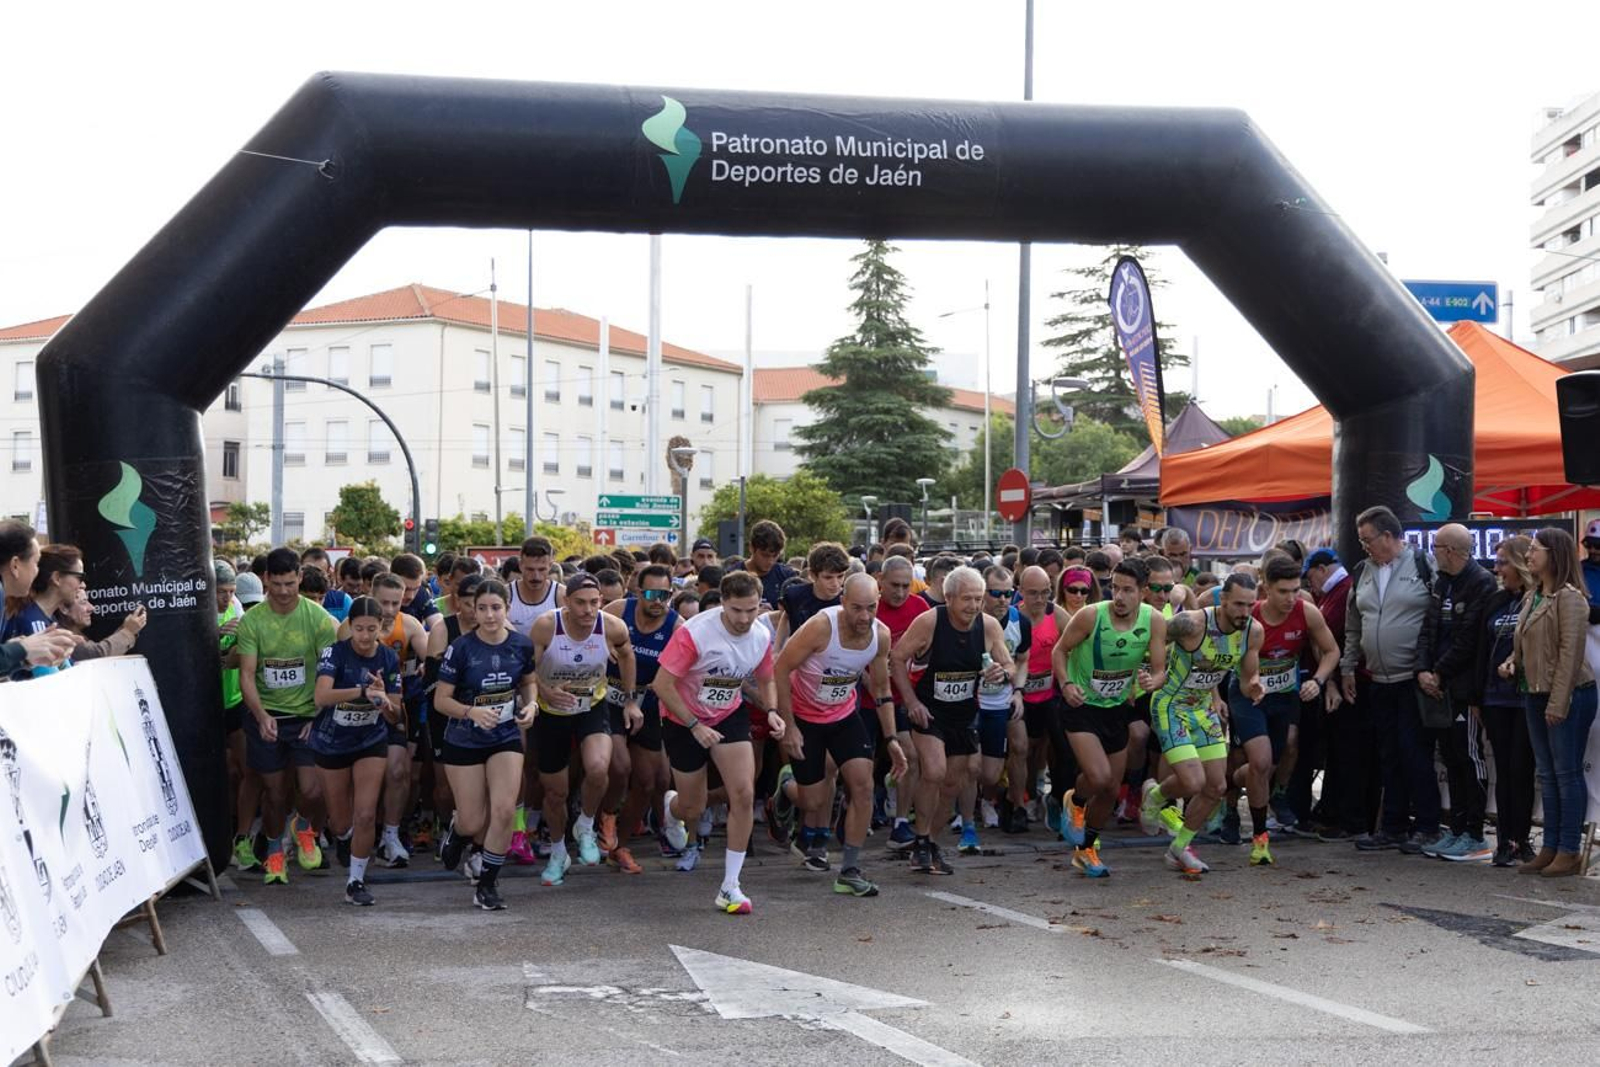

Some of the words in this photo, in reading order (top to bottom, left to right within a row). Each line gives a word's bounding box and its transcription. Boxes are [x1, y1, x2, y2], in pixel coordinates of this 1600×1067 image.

[711, 131, 827, 156] Patronato
[836, 136, 948, 162] Municipal
[956, 141, 985, 161] de
[711, 160, 821, 187] Deportes
[829, 163, 859, 184] de
[866, 163, 922, 186] Jaén
[621, 533, 659, 542] Carrefour
[132, 579, 193, 595] Municipal
[195, 577, 207, 590] de
[148, 597, 165, 609] de
[169, 594, 197, 608] Jaén
[271, 669, 298, 682] 148
[481, 672, 513, 687] 25
[1195, 672, 1222, 684] 202
[1266, 673, 1290, 688] 640
[831, 686, 848, 698] 55
[943, 683, 968, 695] 404
[1099, 680, 1125, 692] 722
[707, 688, 733, 701] 263
[343, 712, 371, 722] 432
